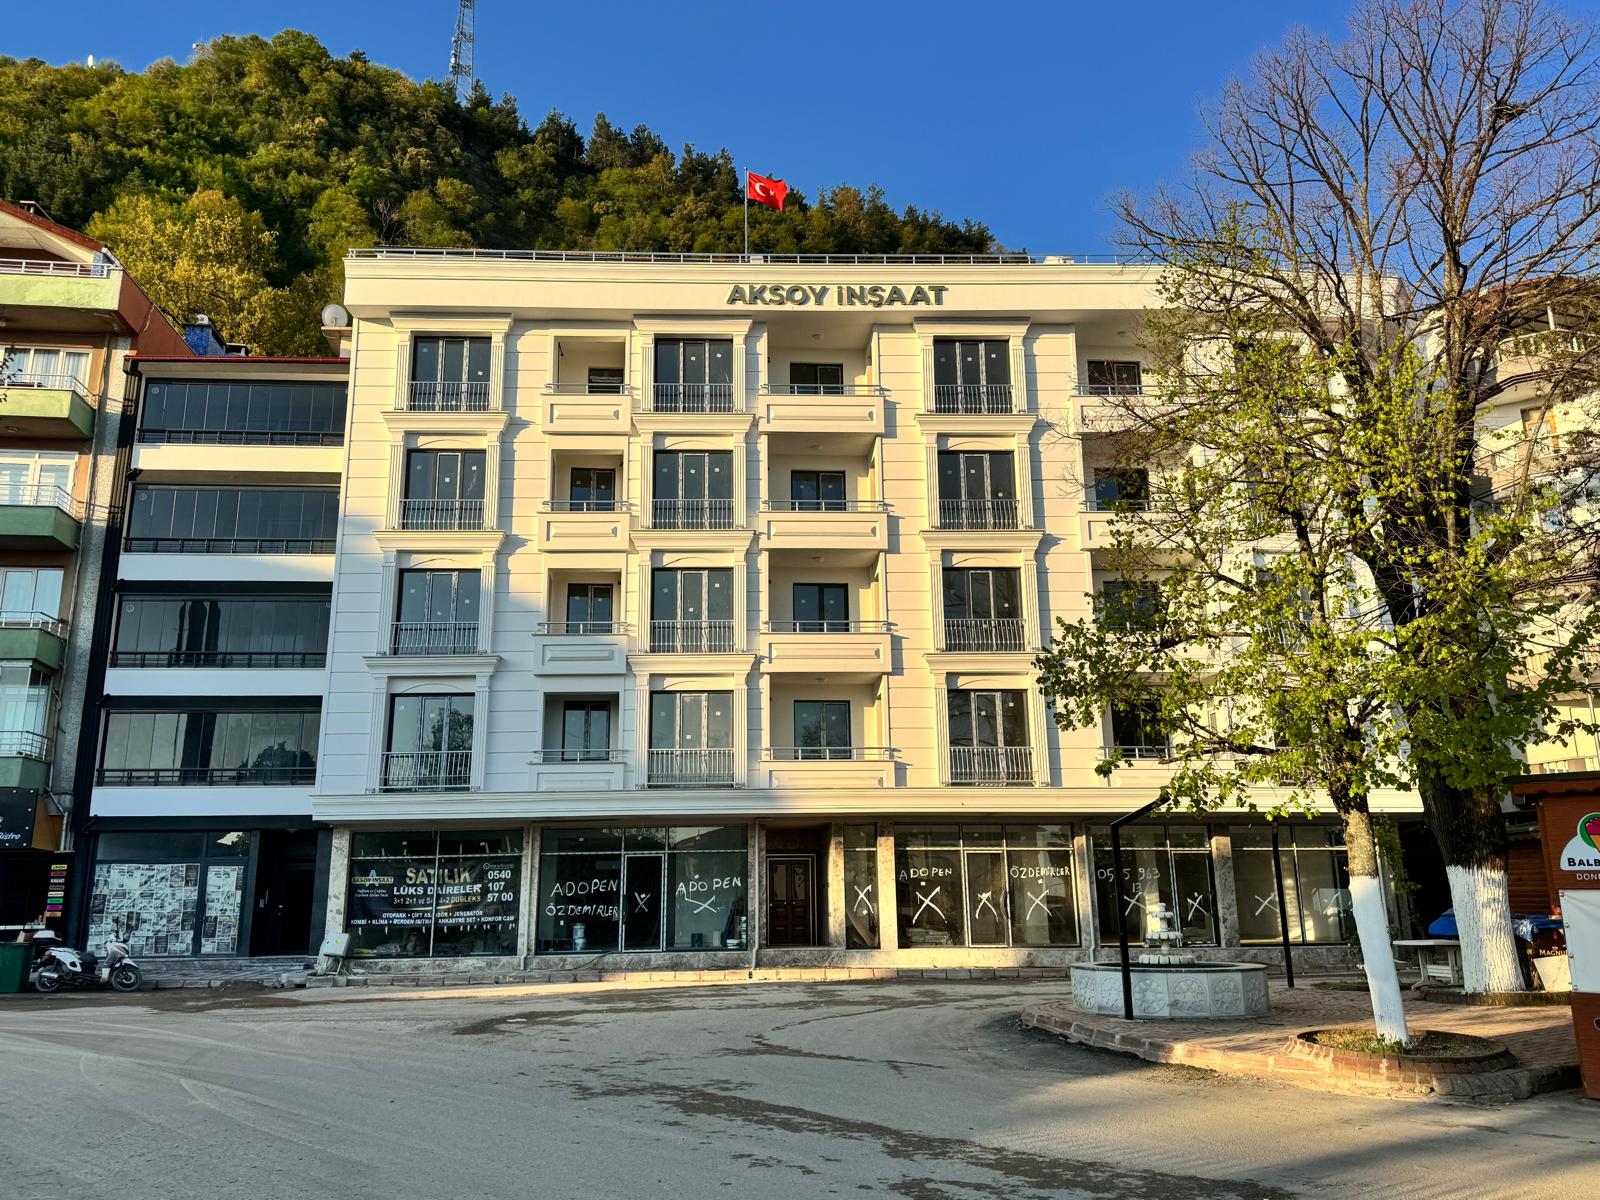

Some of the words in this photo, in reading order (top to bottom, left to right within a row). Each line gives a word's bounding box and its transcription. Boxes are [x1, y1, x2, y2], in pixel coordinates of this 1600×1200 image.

[727, 285, 830, 306] AKSOY
[406, 867, 471, 884] SATILIK
[487, 870, 511, 880] 0540
[393, 885, 424, 895] LÜKS
[488, 882, 505, 891] 107
[487, 893, 499, 902] 57
[501, 892, 514, 902] 00
